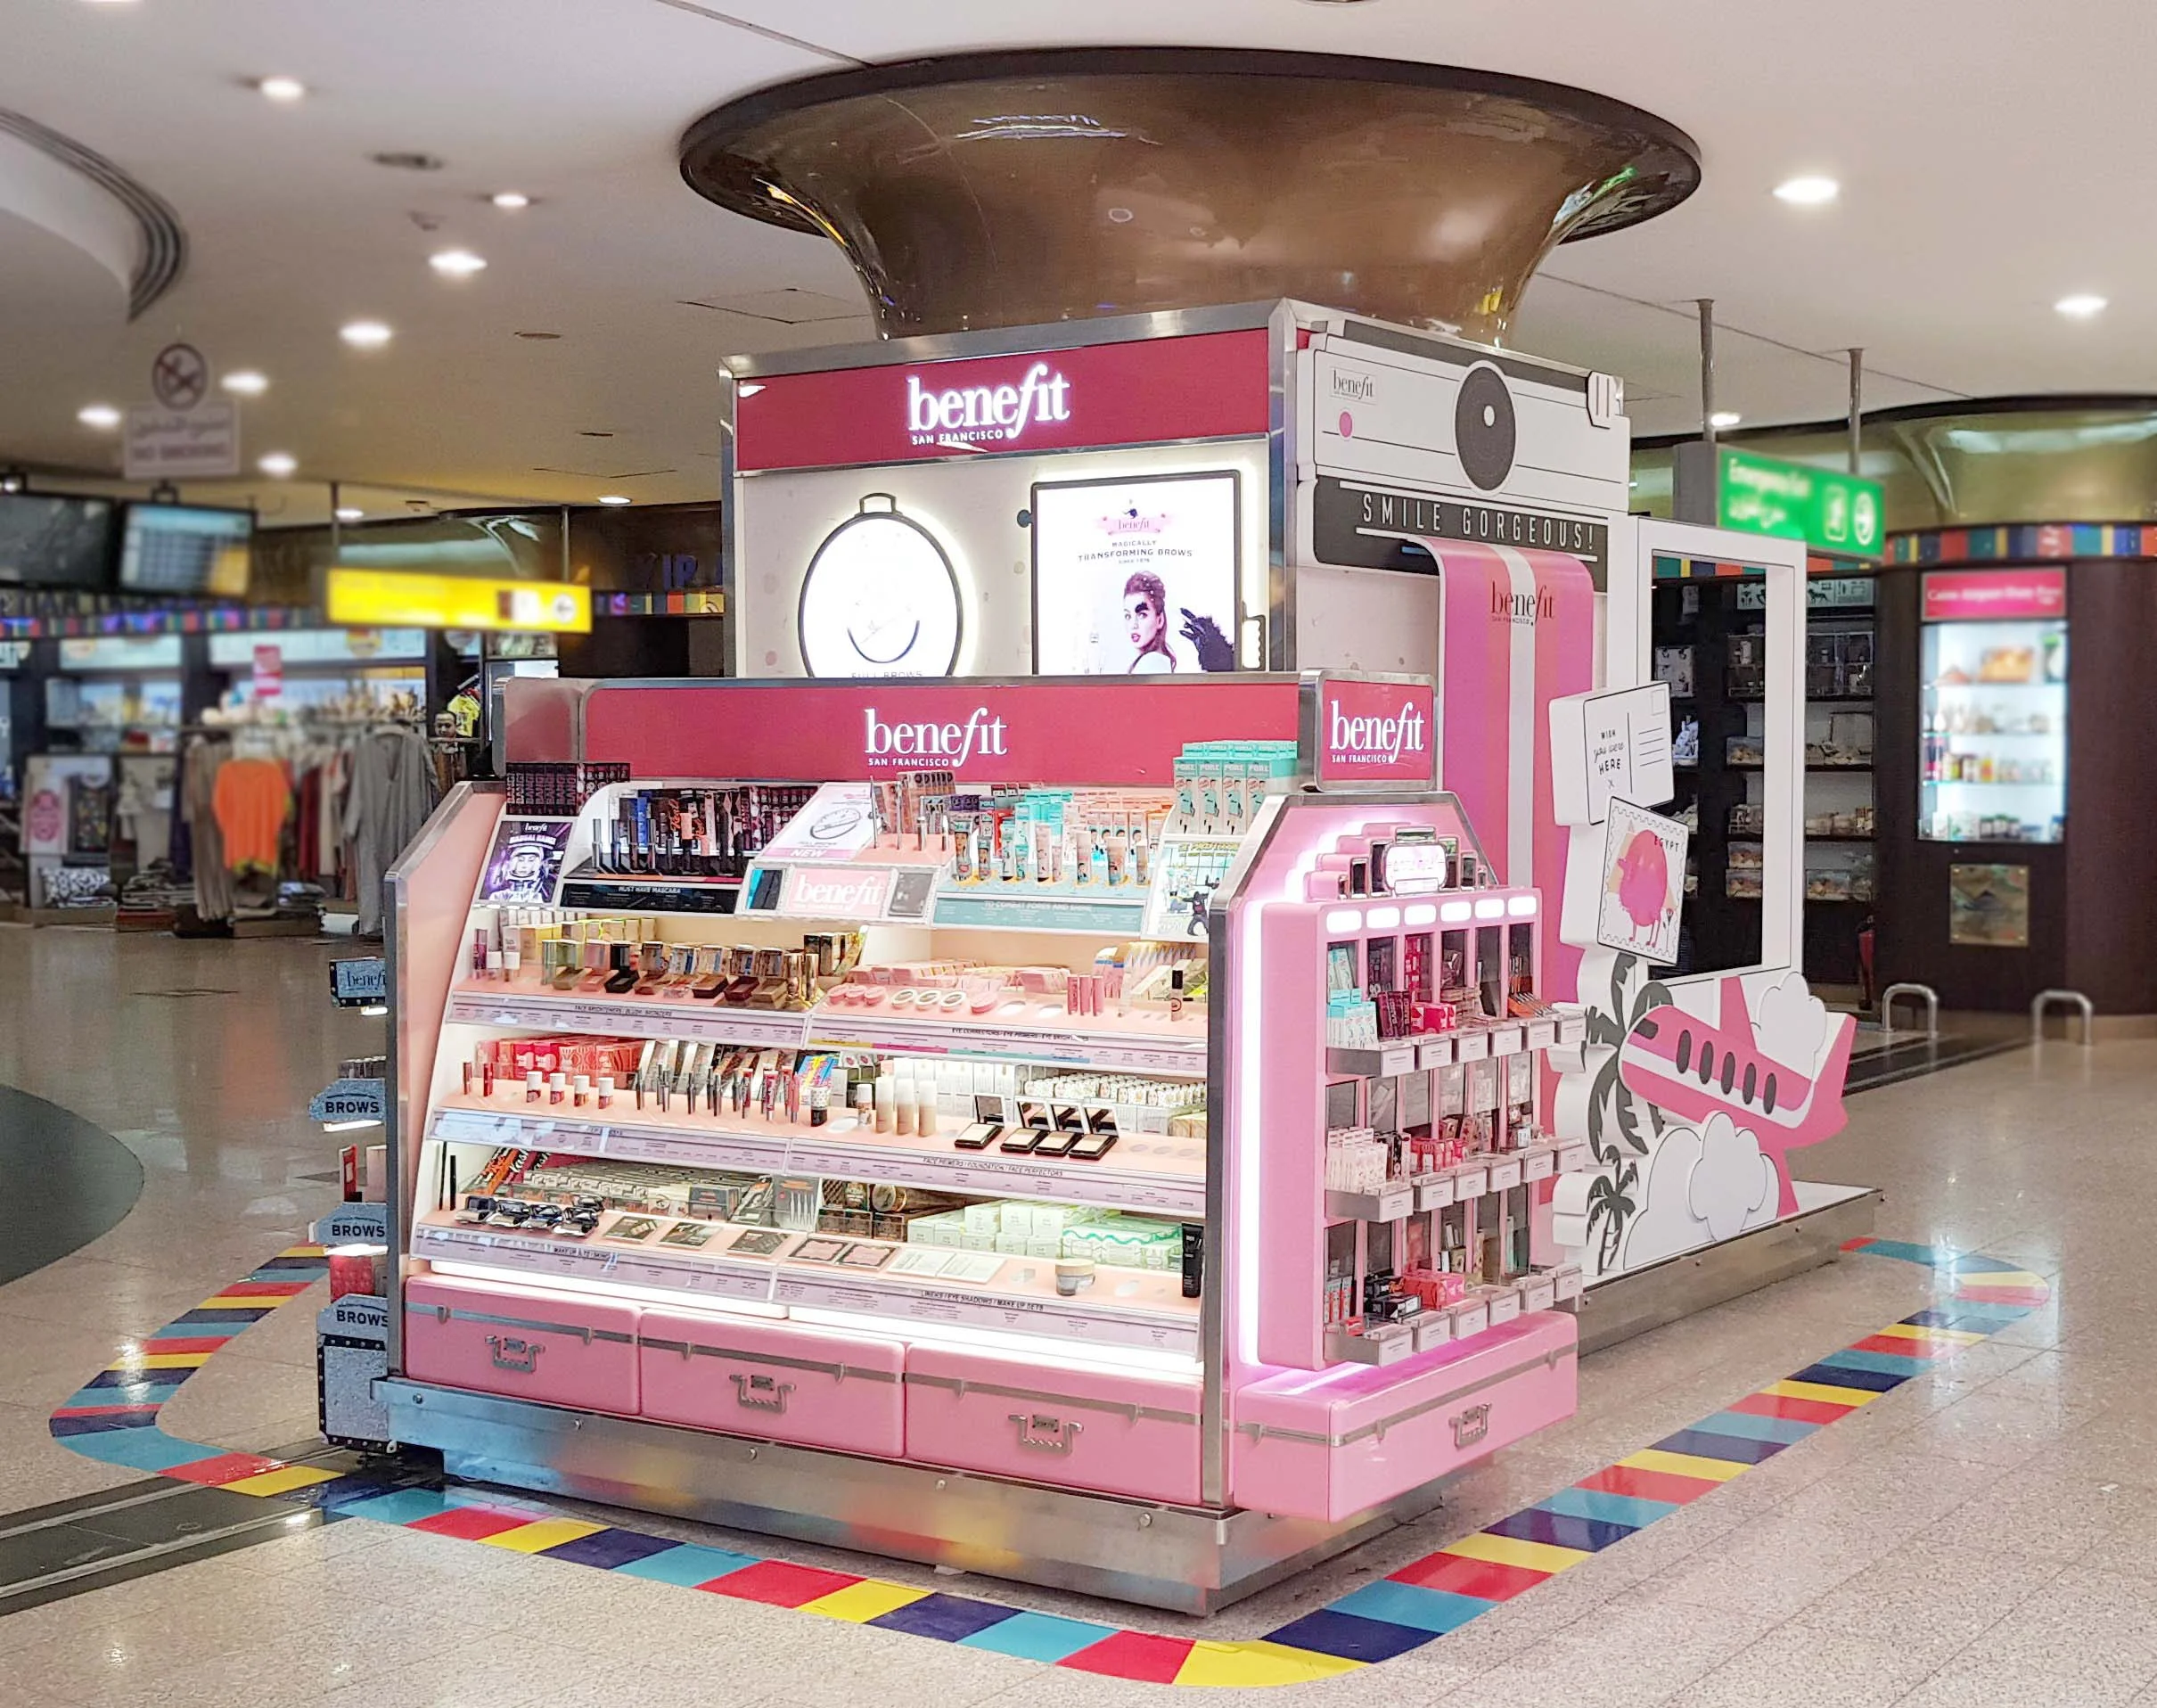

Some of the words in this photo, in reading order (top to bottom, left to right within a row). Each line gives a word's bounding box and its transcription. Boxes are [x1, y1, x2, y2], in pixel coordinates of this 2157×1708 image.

[1333, 369, 1373, 399] benefit
[907, 363, 1070, 439] benefit
[912, 434, 934, 445] SAN
[939, 430, 1004, 443] FRANCISCO
[1363, 493, 1441, 531] SMILE
[1463, 507, 1595, 551] GORGEOUS!
[1111, 539, 1157, 547] MAGICALLY
[1078, 548, 1154, 562] TRANSFORMING
[1158, 548, 1193, 557] BROWS
[1490, 581, 1555, 626] benefit
[864, 707, 1008, 767] benefit
[1330, 700, 1424, 763] benefit
[868, 758, 888, 766] SAN
[893, 758, 949, 767] FRANCISCO
[1332, 754, 1346, 763] SAN
[1349, 754, 1387, 763] FRANCISCO
[1598, 758, 1620, 776] HERE
[1654, 835, 1679, 852] EGYPT
[790, 849, 827, 857] NEW
[796, 875, 883, 912] benefit
[347, 969, 387, 991] benefi
[324, 1101, 380, 1113] BROWS
[332, 1224, 385, 1237] BROWS
[336, 1310, 389, 1327] BROWS
